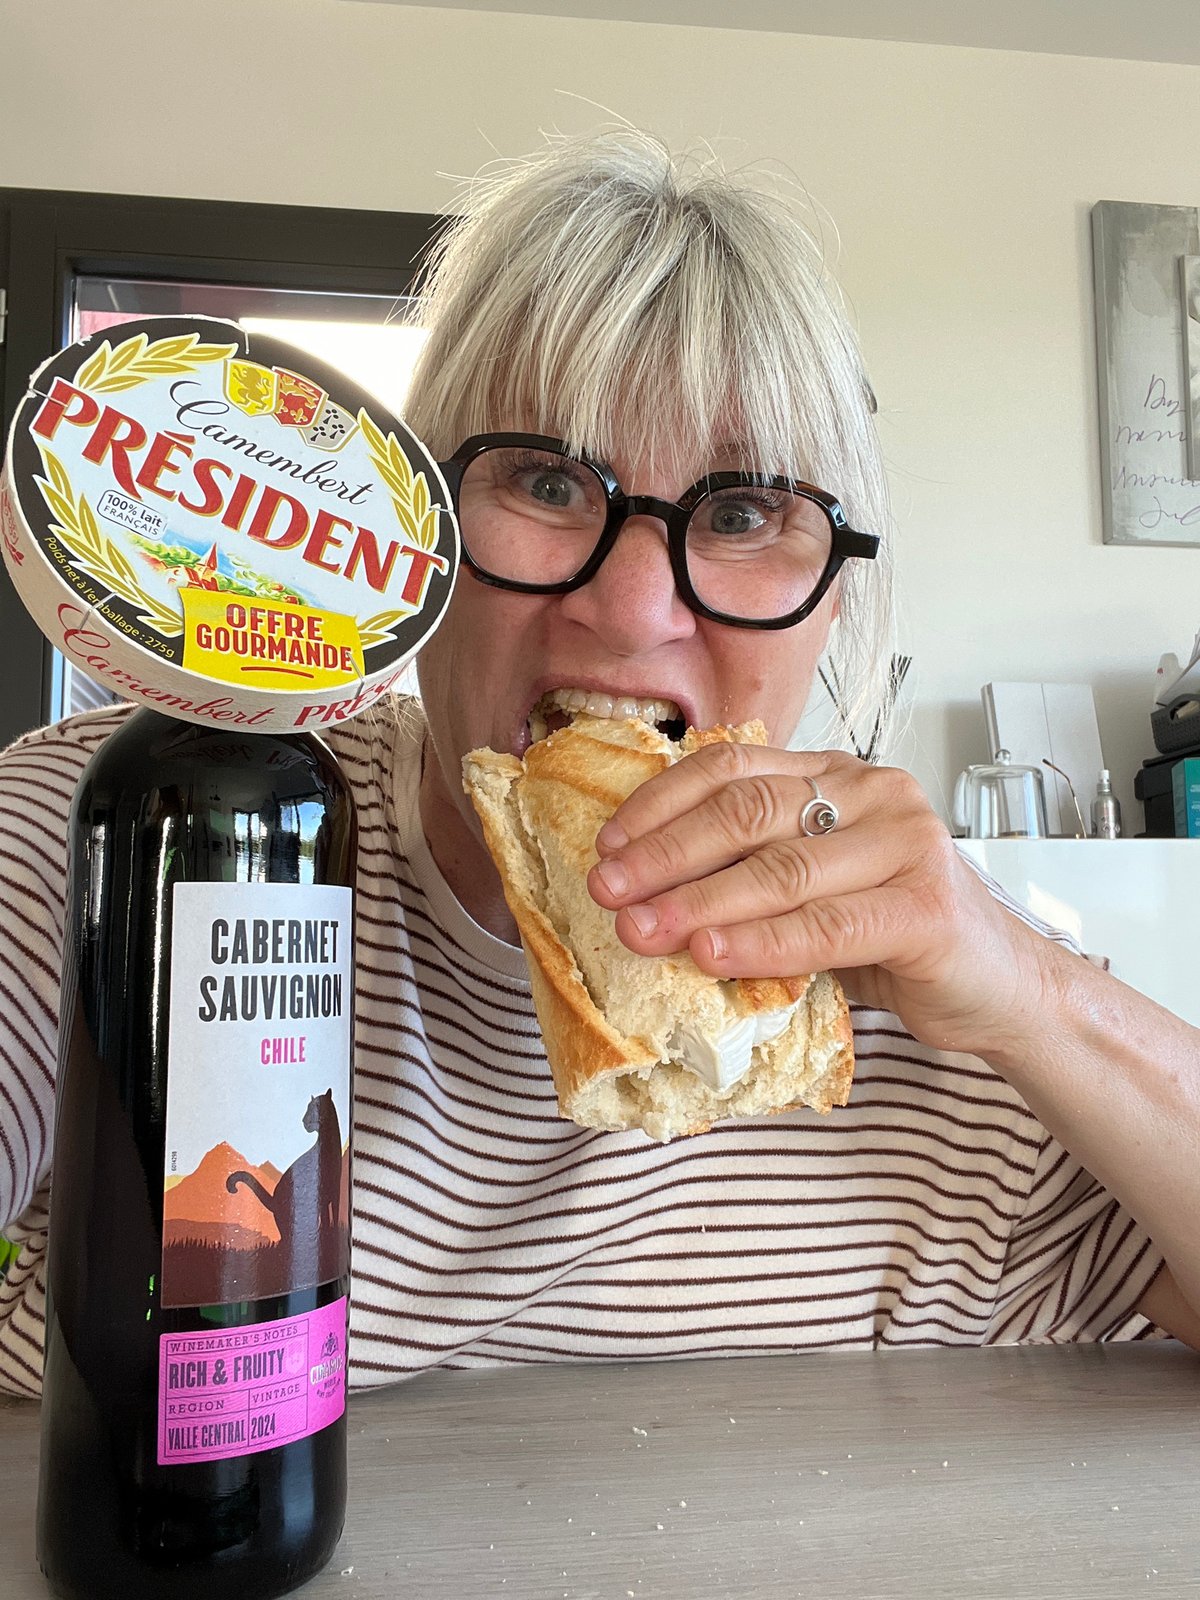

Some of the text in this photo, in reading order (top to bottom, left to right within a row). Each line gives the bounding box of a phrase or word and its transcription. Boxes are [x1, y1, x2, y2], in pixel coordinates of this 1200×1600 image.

[169, 380, 375, 505] Camembert
[32, 379, 445, 608] PRÉSIDENT
[107, 494, 162, 527] 100% lait
[103, 505, 159, 536] FRANÇAIS
[44, 536, 67, 564] Poids
[62, 563, 80, 582] net
[76, 580, 86, 591] à
[144, 635, 175, 658] 275g
[226, 603, 323, 642] OFFRE
[57, 602, 276, 725] Camembert
[196, 623, 353, 672] GOURMANDE
[211, 918, 339, 965] CABERNET
[198, 973, 342, 1022] SAUVIGNON
[260, 1036, 307, 1065] CHILE
[170, 1325, 299, 1353] WINEMAKER'S NOTES
[168, 1360, 207, 1390] RICH
[212, 1358, 228, 1386] &
[233, 1347, 285, 1383] FRUITY
[168, 1400, 225, 1415] REGION
[252, 1383, 301, 1404] VINTAGE
[168, 1419, 246, 1450] VALLE CENTRAL
[250, 1413, 276, 1439] 2024
